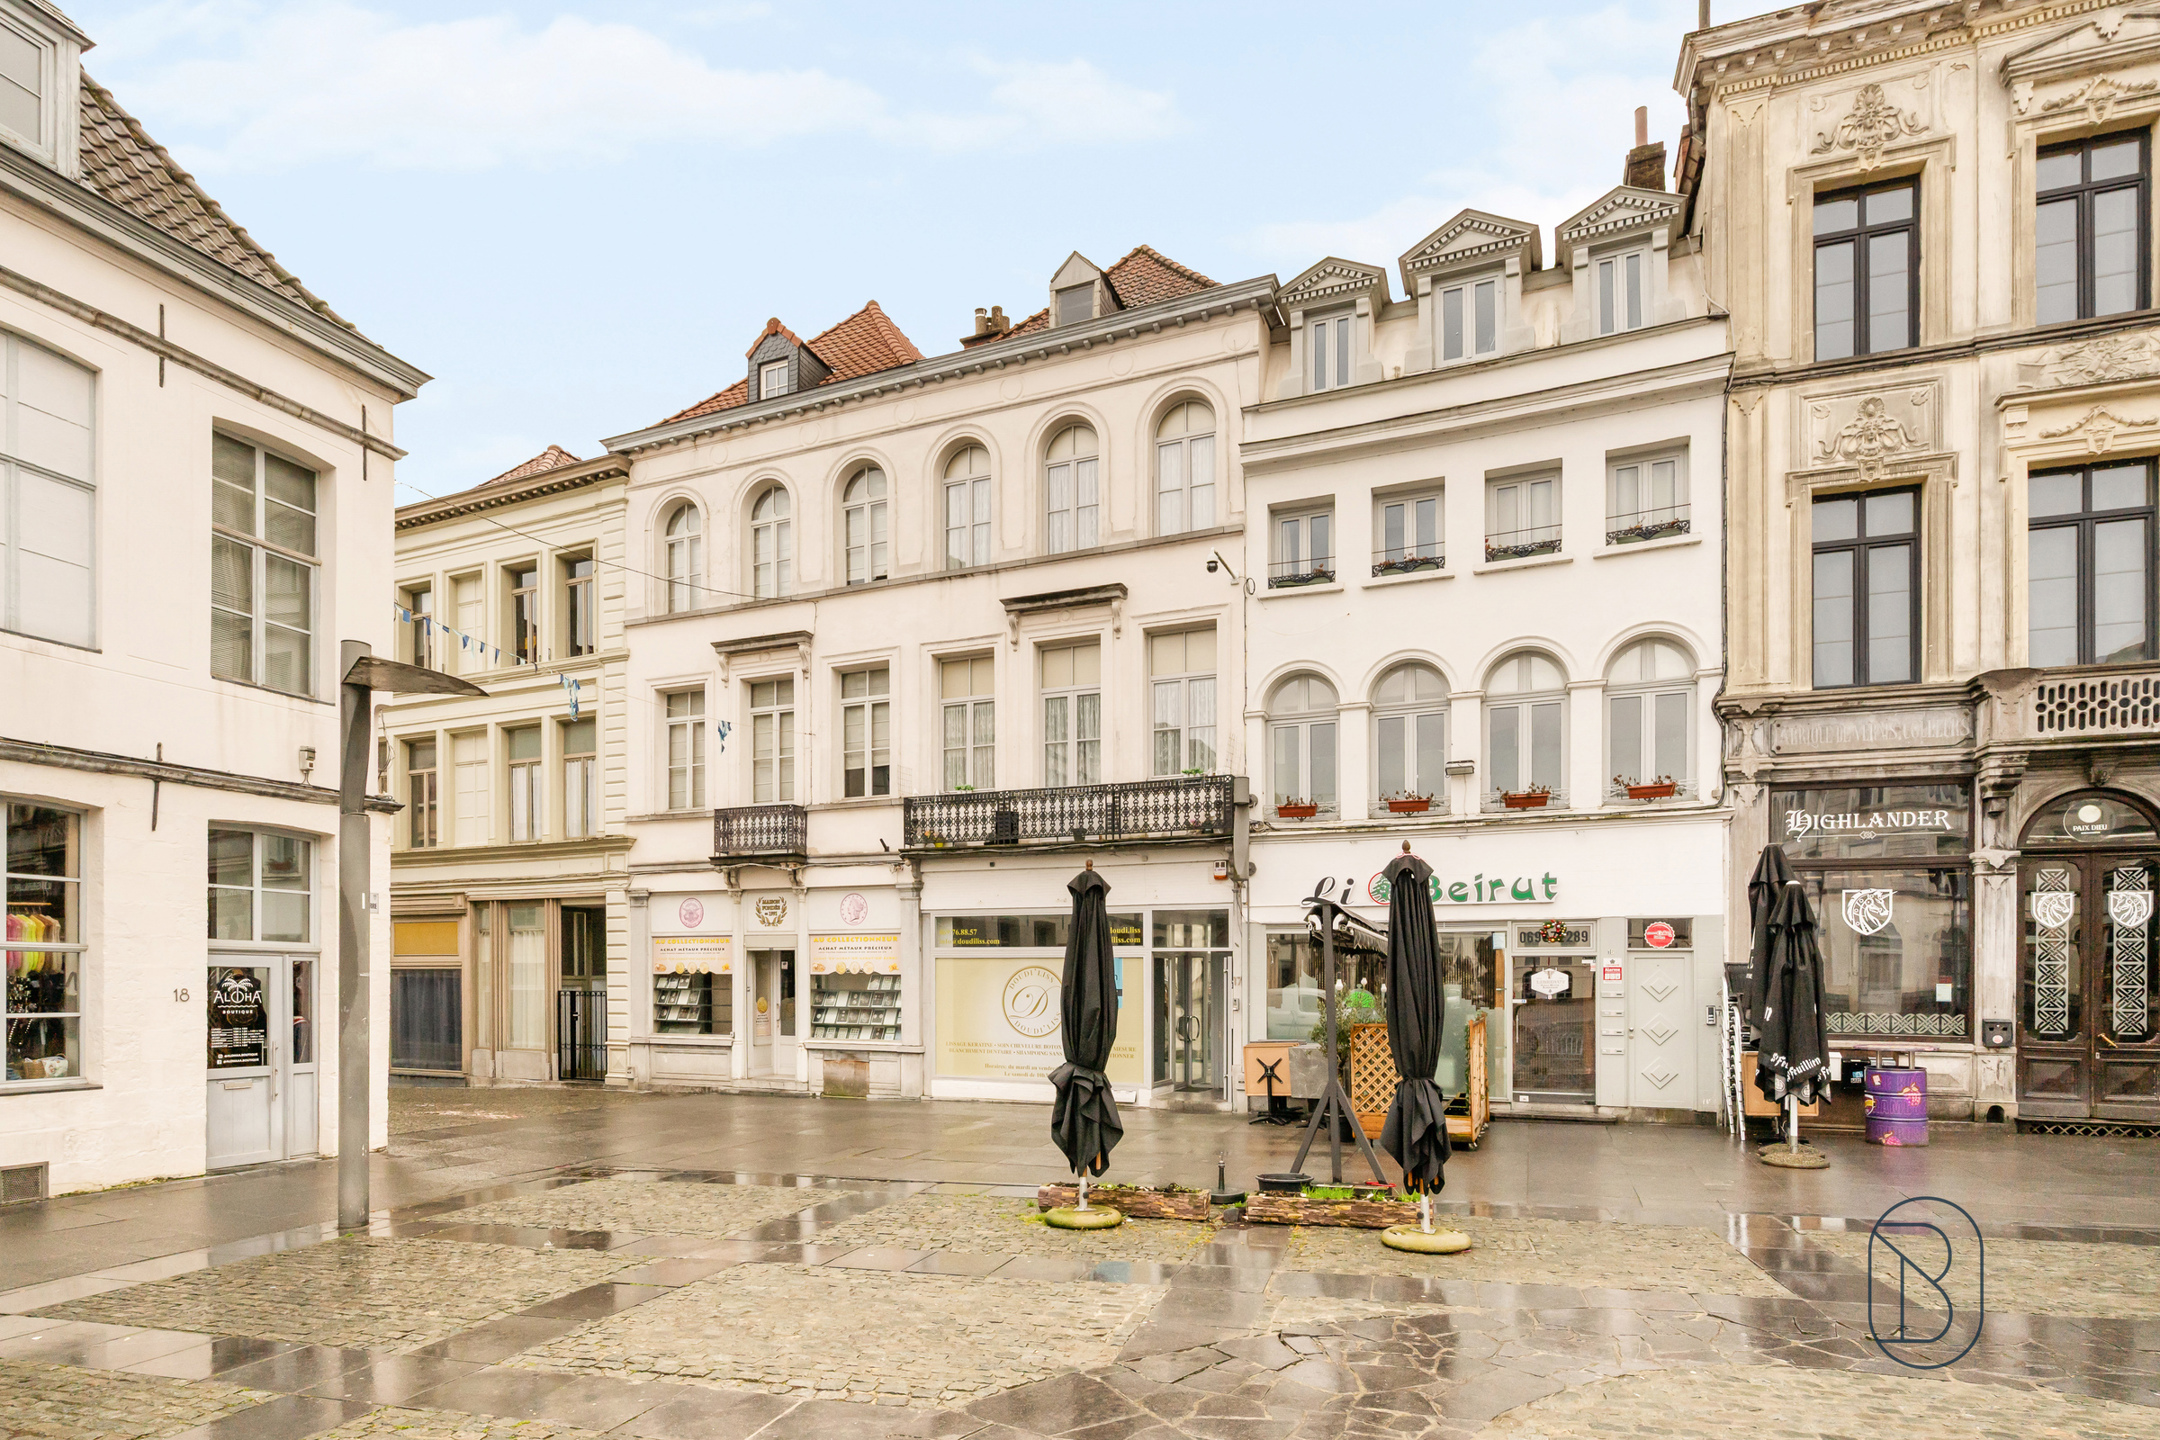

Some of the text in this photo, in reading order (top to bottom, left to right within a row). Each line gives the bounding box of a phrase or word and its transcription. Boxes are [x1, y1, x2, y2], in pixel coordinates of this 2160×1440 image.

[2091, 823, 2108, 831] DIEU
[1301, 871, 1558, 906] Li Beirut
[1519, 930, 1589, 944] 0697289
[173, 987, 190, 1002] 18
[213, 990, 262, 1004] ALOHA
